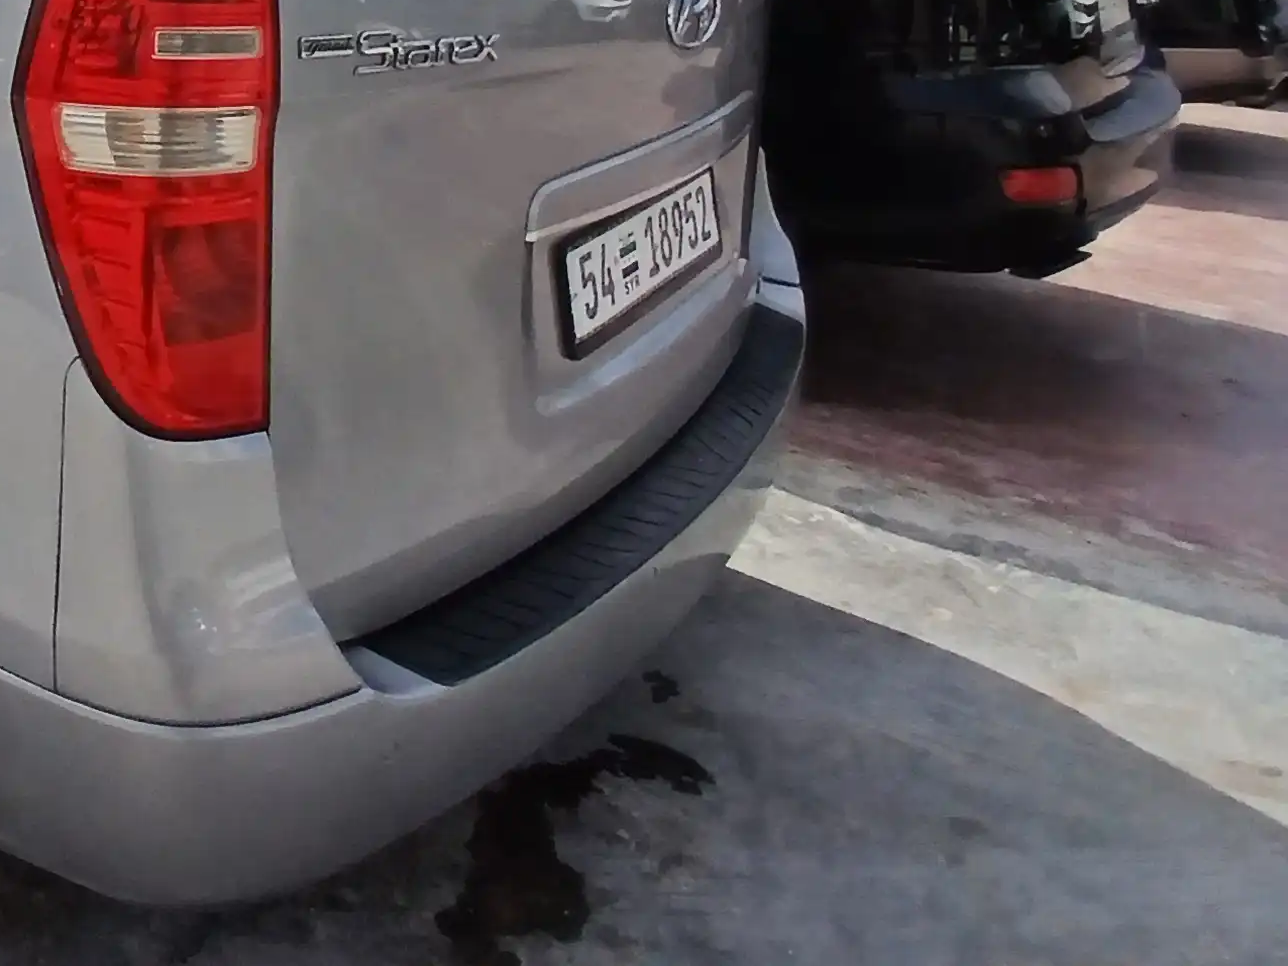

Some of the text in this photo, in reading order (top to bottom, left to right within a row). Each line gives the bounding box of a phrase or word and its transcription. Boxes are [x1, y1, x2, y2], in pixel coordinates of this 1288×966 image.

[352, 29, 501, 77] Starex
[578, 185, 712, 320] 54 18952
